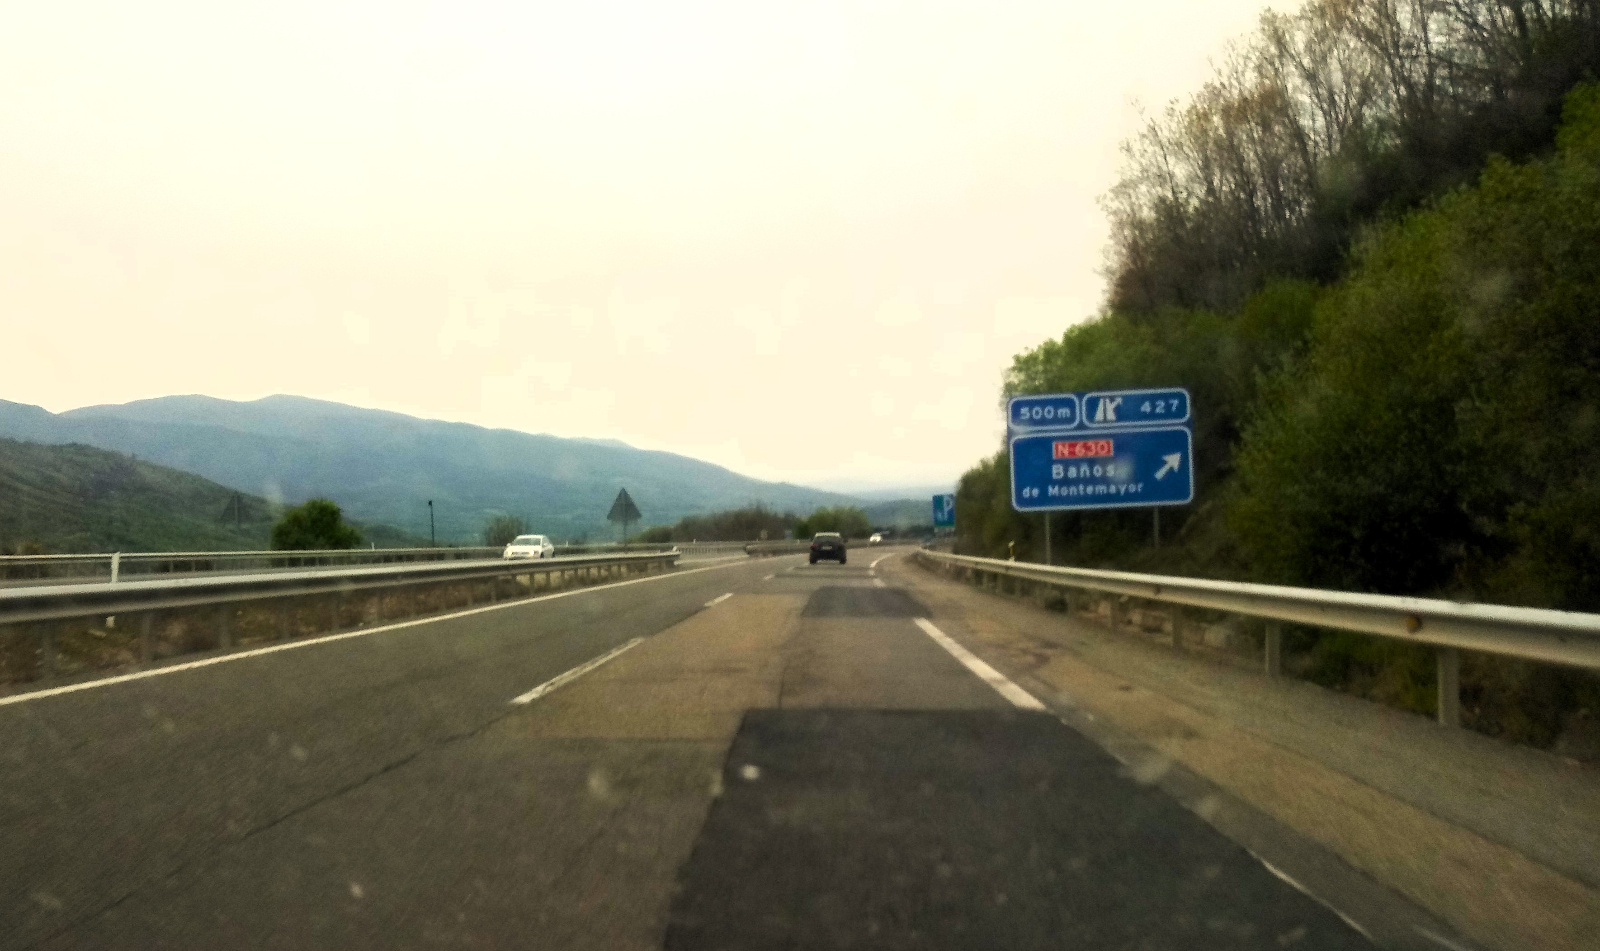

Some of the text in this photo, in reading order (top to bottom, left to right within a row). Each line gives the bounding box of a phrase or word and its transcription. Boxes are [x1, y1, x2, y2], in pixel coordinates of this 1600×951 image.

[1140, 398, 1179, 414] 427
[1022, 482, 1144, 499] de Montemayor
